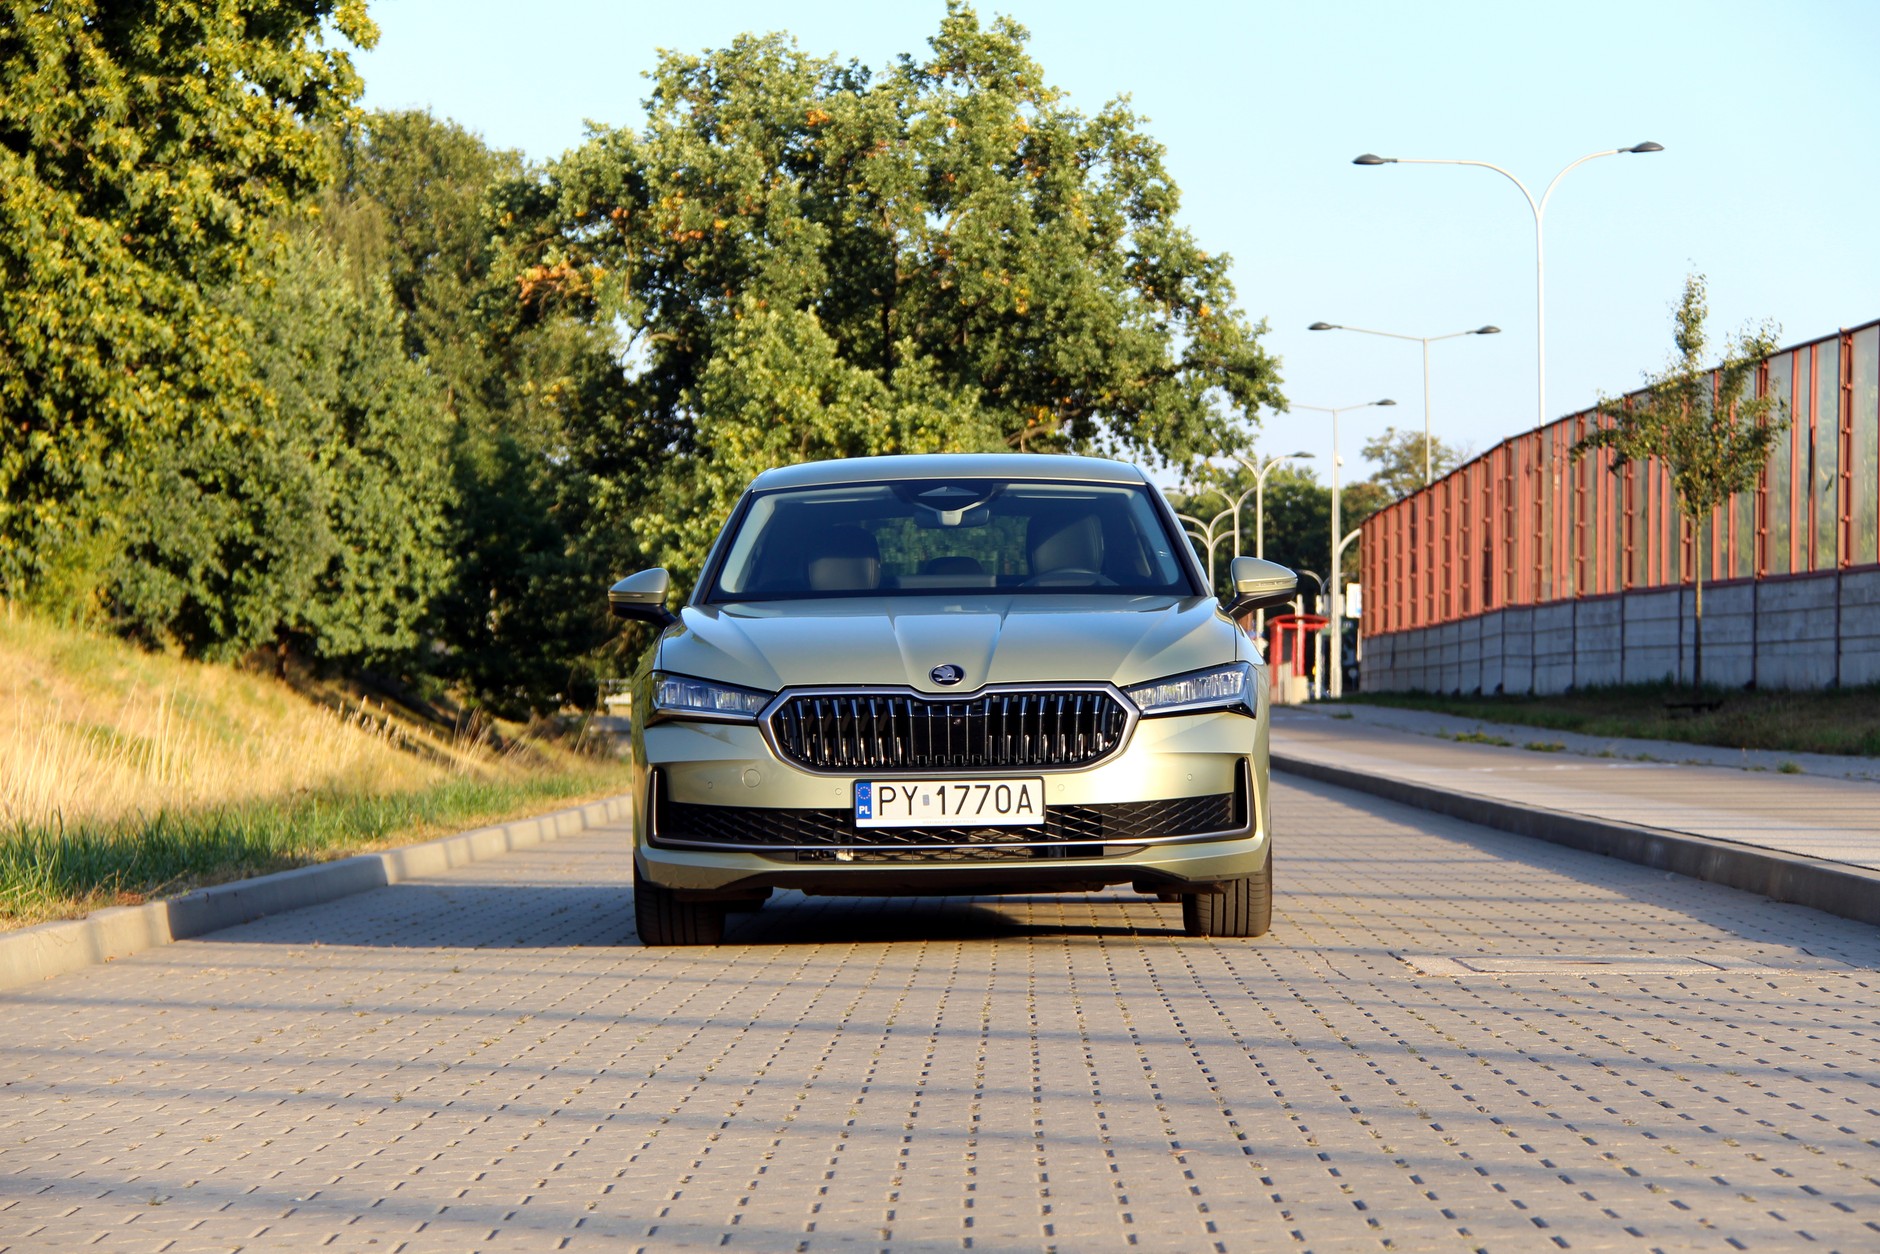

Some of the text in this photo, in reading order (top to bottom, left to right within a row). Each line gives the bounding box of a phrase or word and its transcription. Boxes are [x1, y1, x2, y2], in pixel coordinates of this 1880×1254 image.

[879, 784, 1033, 816] PY 1770A
[859, 806, 870, 815] PL
